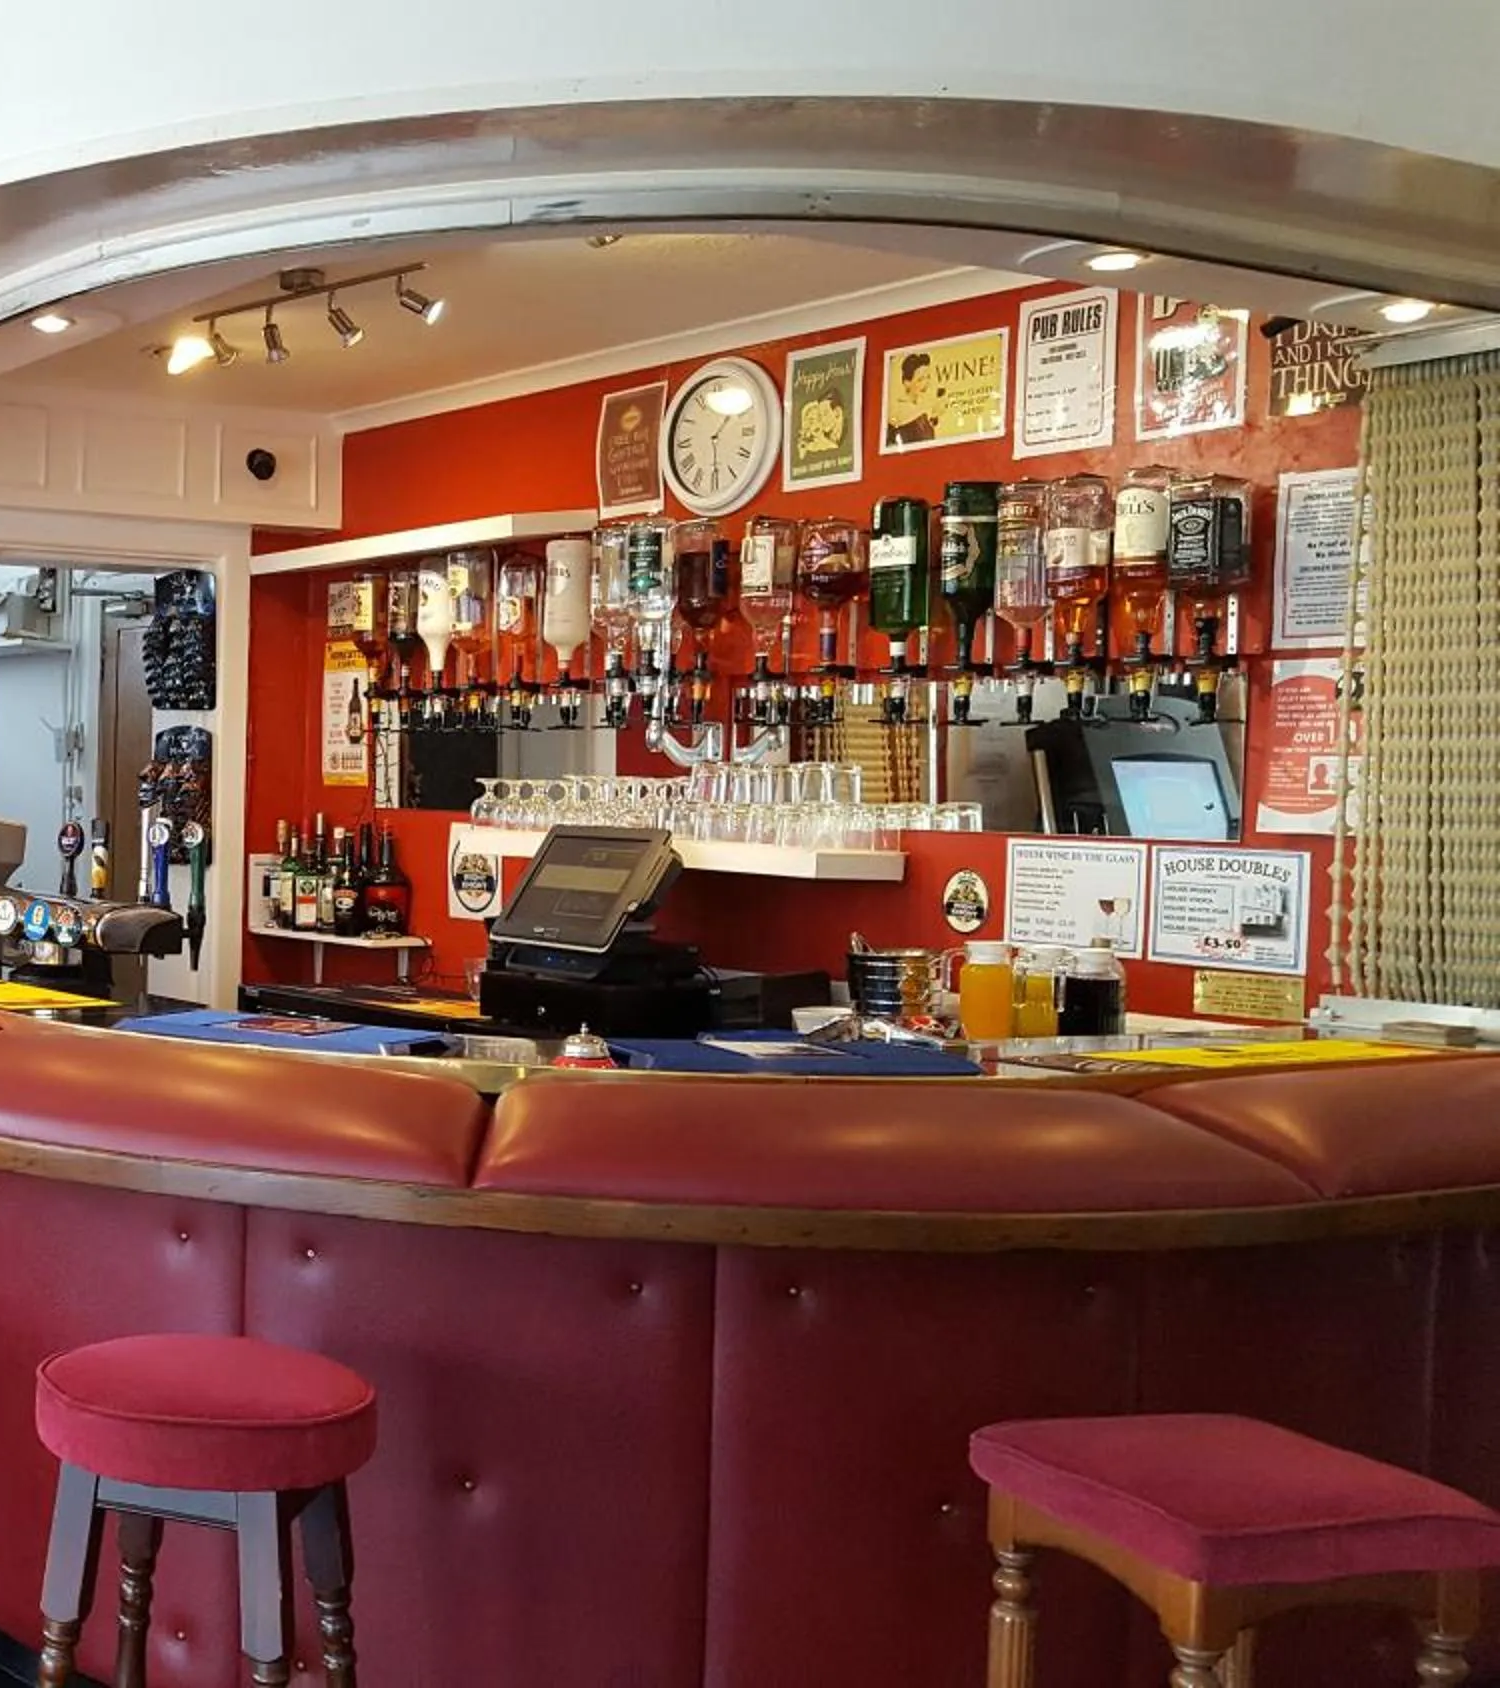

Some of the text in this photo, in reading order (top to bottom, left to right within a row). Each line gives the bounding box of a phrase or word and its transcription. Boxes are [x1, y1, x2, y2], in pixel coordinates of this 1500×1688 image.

[1032, 304, 1103, 343] PUB RULES
[1274, 343, 1313, 366] AND
[1316, 341, 1322, 361] I
[935, 355, 995, 383] WINE!
[1293, 731, 1325, 744] OVER
[1163, 857, 1292, 883] HOUSE DOUBLES
